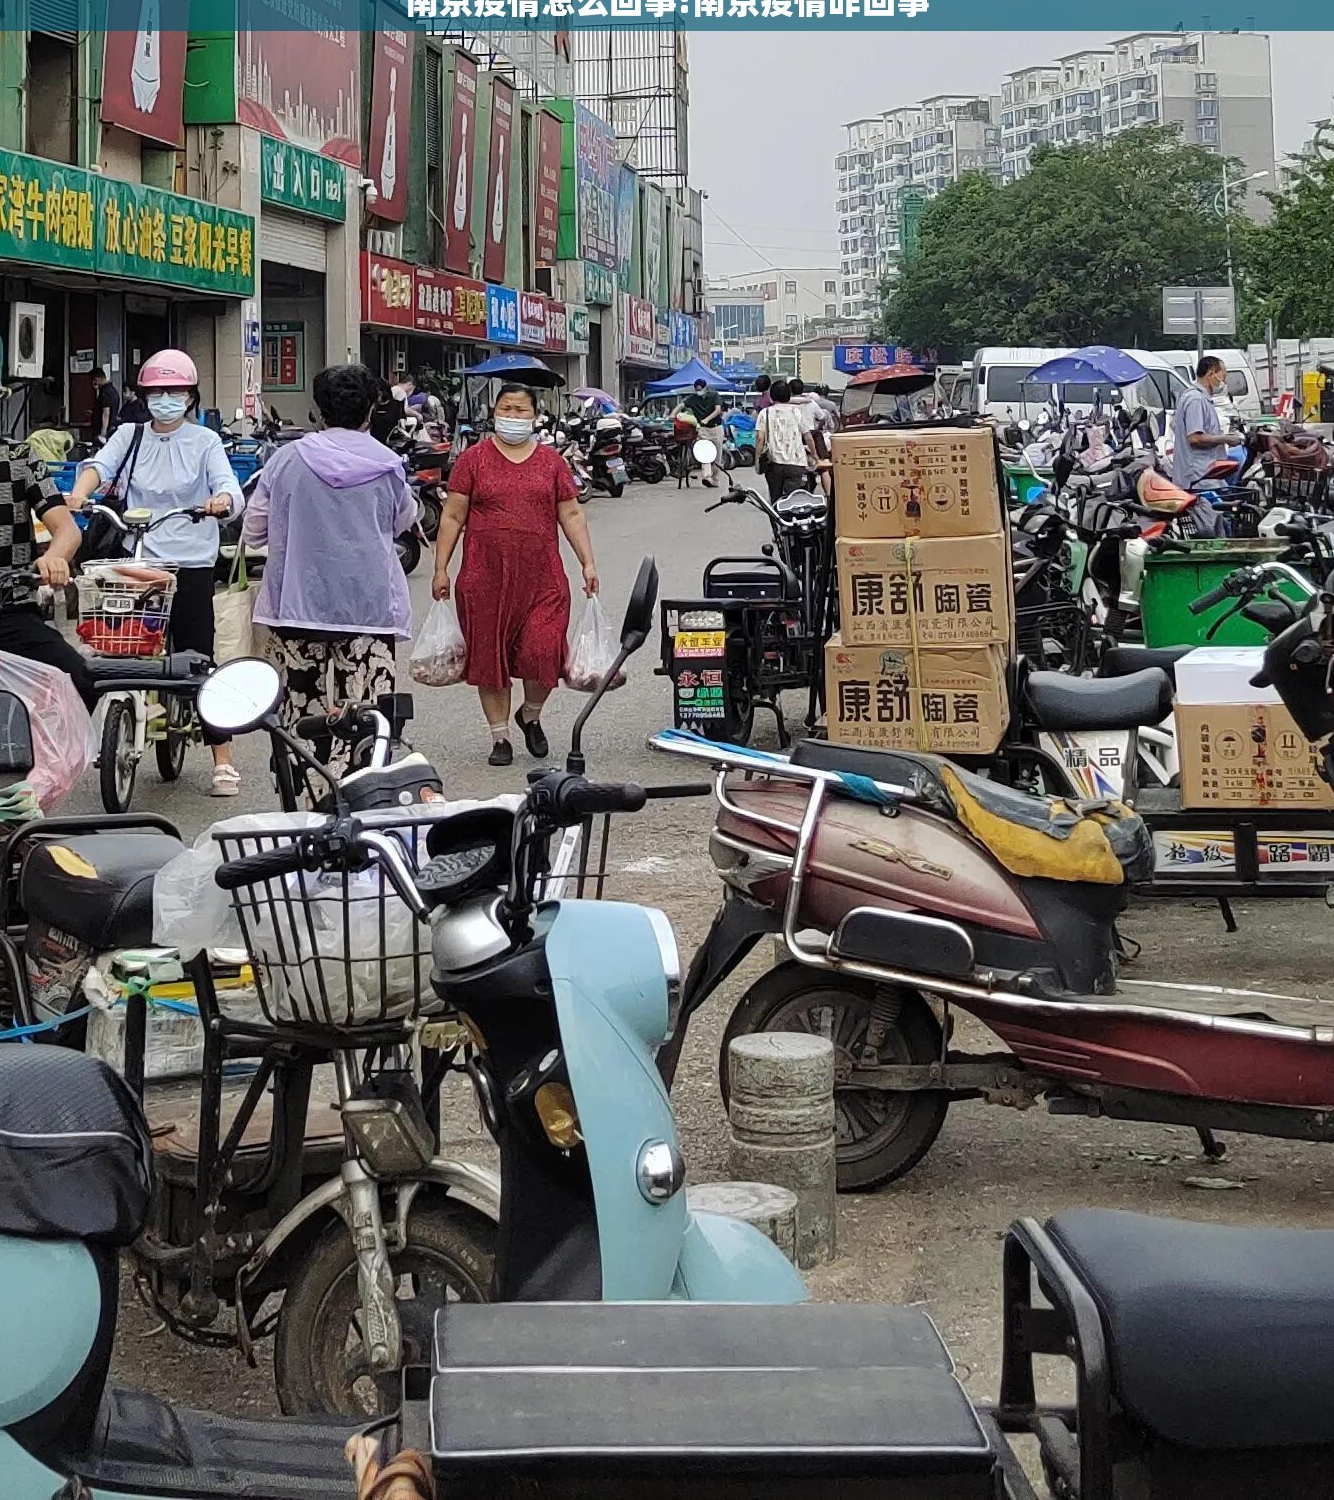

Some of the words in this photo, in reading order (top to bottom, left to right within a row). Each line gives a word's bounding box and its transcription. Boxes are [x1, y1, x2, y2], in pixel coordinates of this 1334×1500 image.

[273, 152, 320, 201] 出入口
[104, 197, 168, 264] 放心油条
[169, 213, 252, 278] 豆浆阳光早餐
[677, 669, 724, 688] 永恒
[1065, 747, 1121, 768] 精品
[1164, 843, 1228, 864] 超级
[1268, 844, 1331, 864] 路霸
